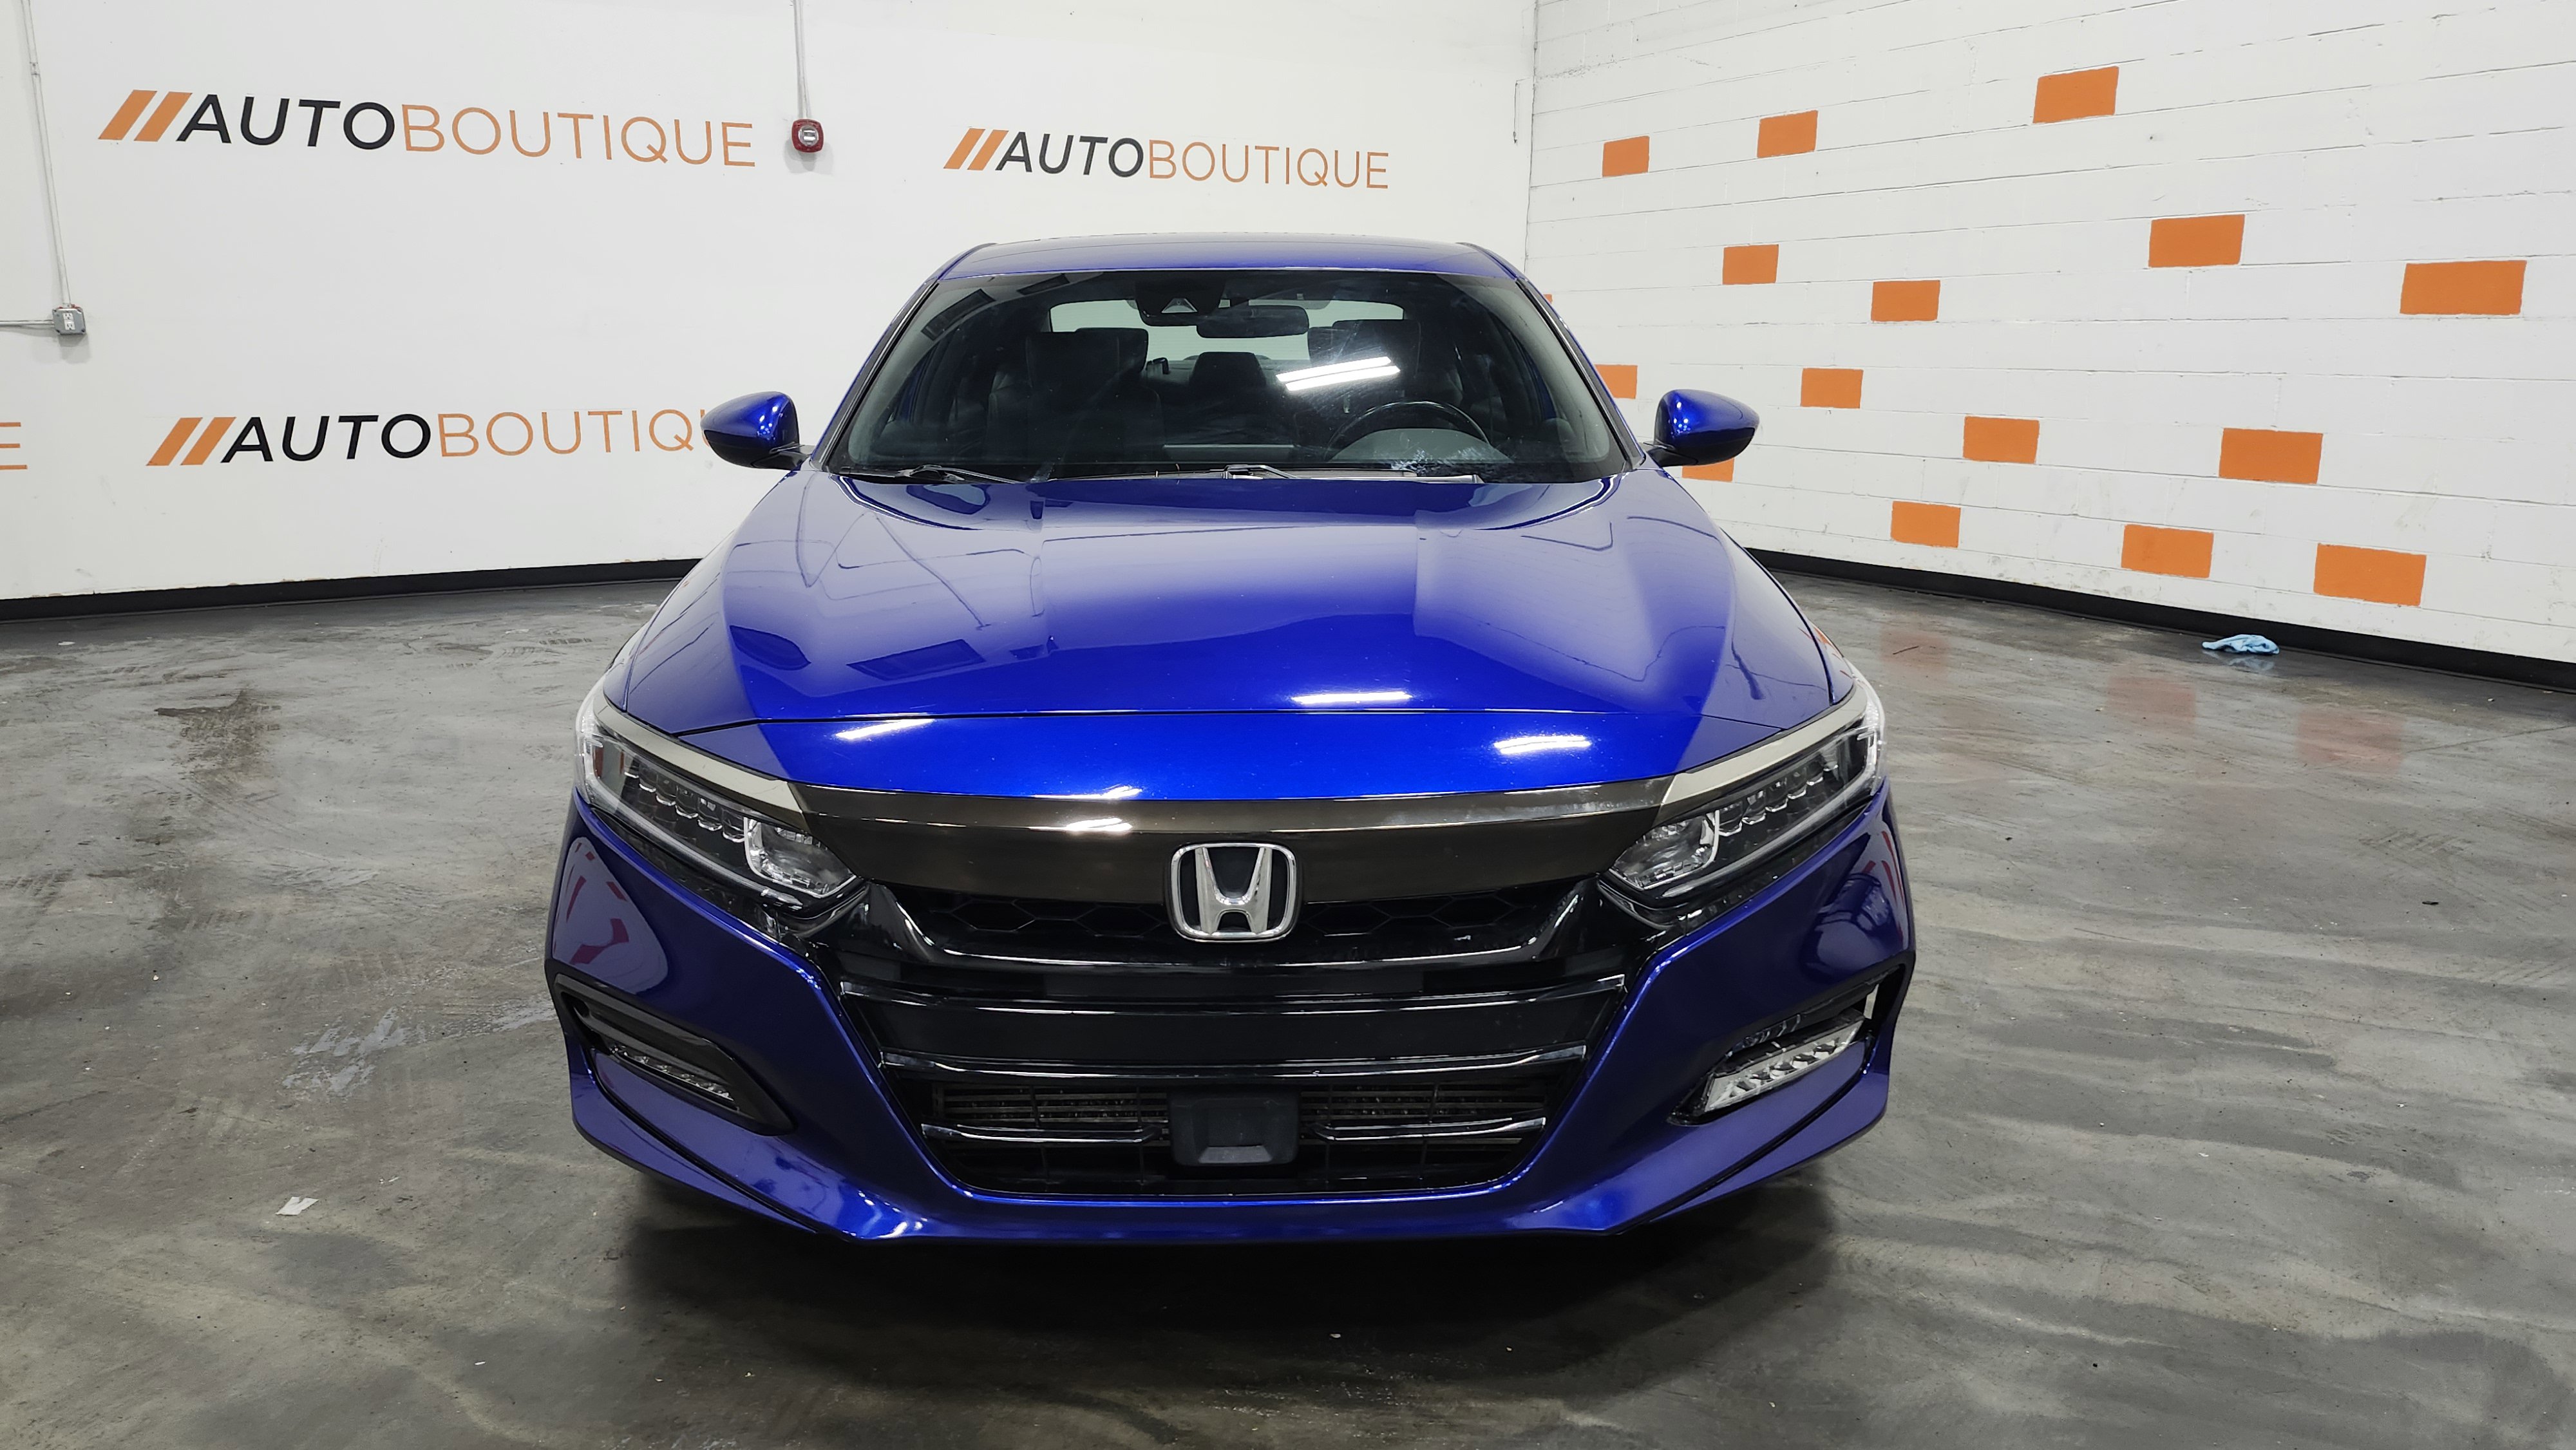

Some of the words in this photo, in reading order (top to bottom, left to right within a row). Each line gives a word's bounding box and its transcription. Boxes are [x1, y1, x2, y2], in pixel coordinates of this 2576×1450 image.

[176, 94, 755, 167] AUTOBOUTIQUE
[995, 131, 1388, 189] AUTOBOUTIQUE
[220, 409, 710, 464] AUTOBOUTIQ
